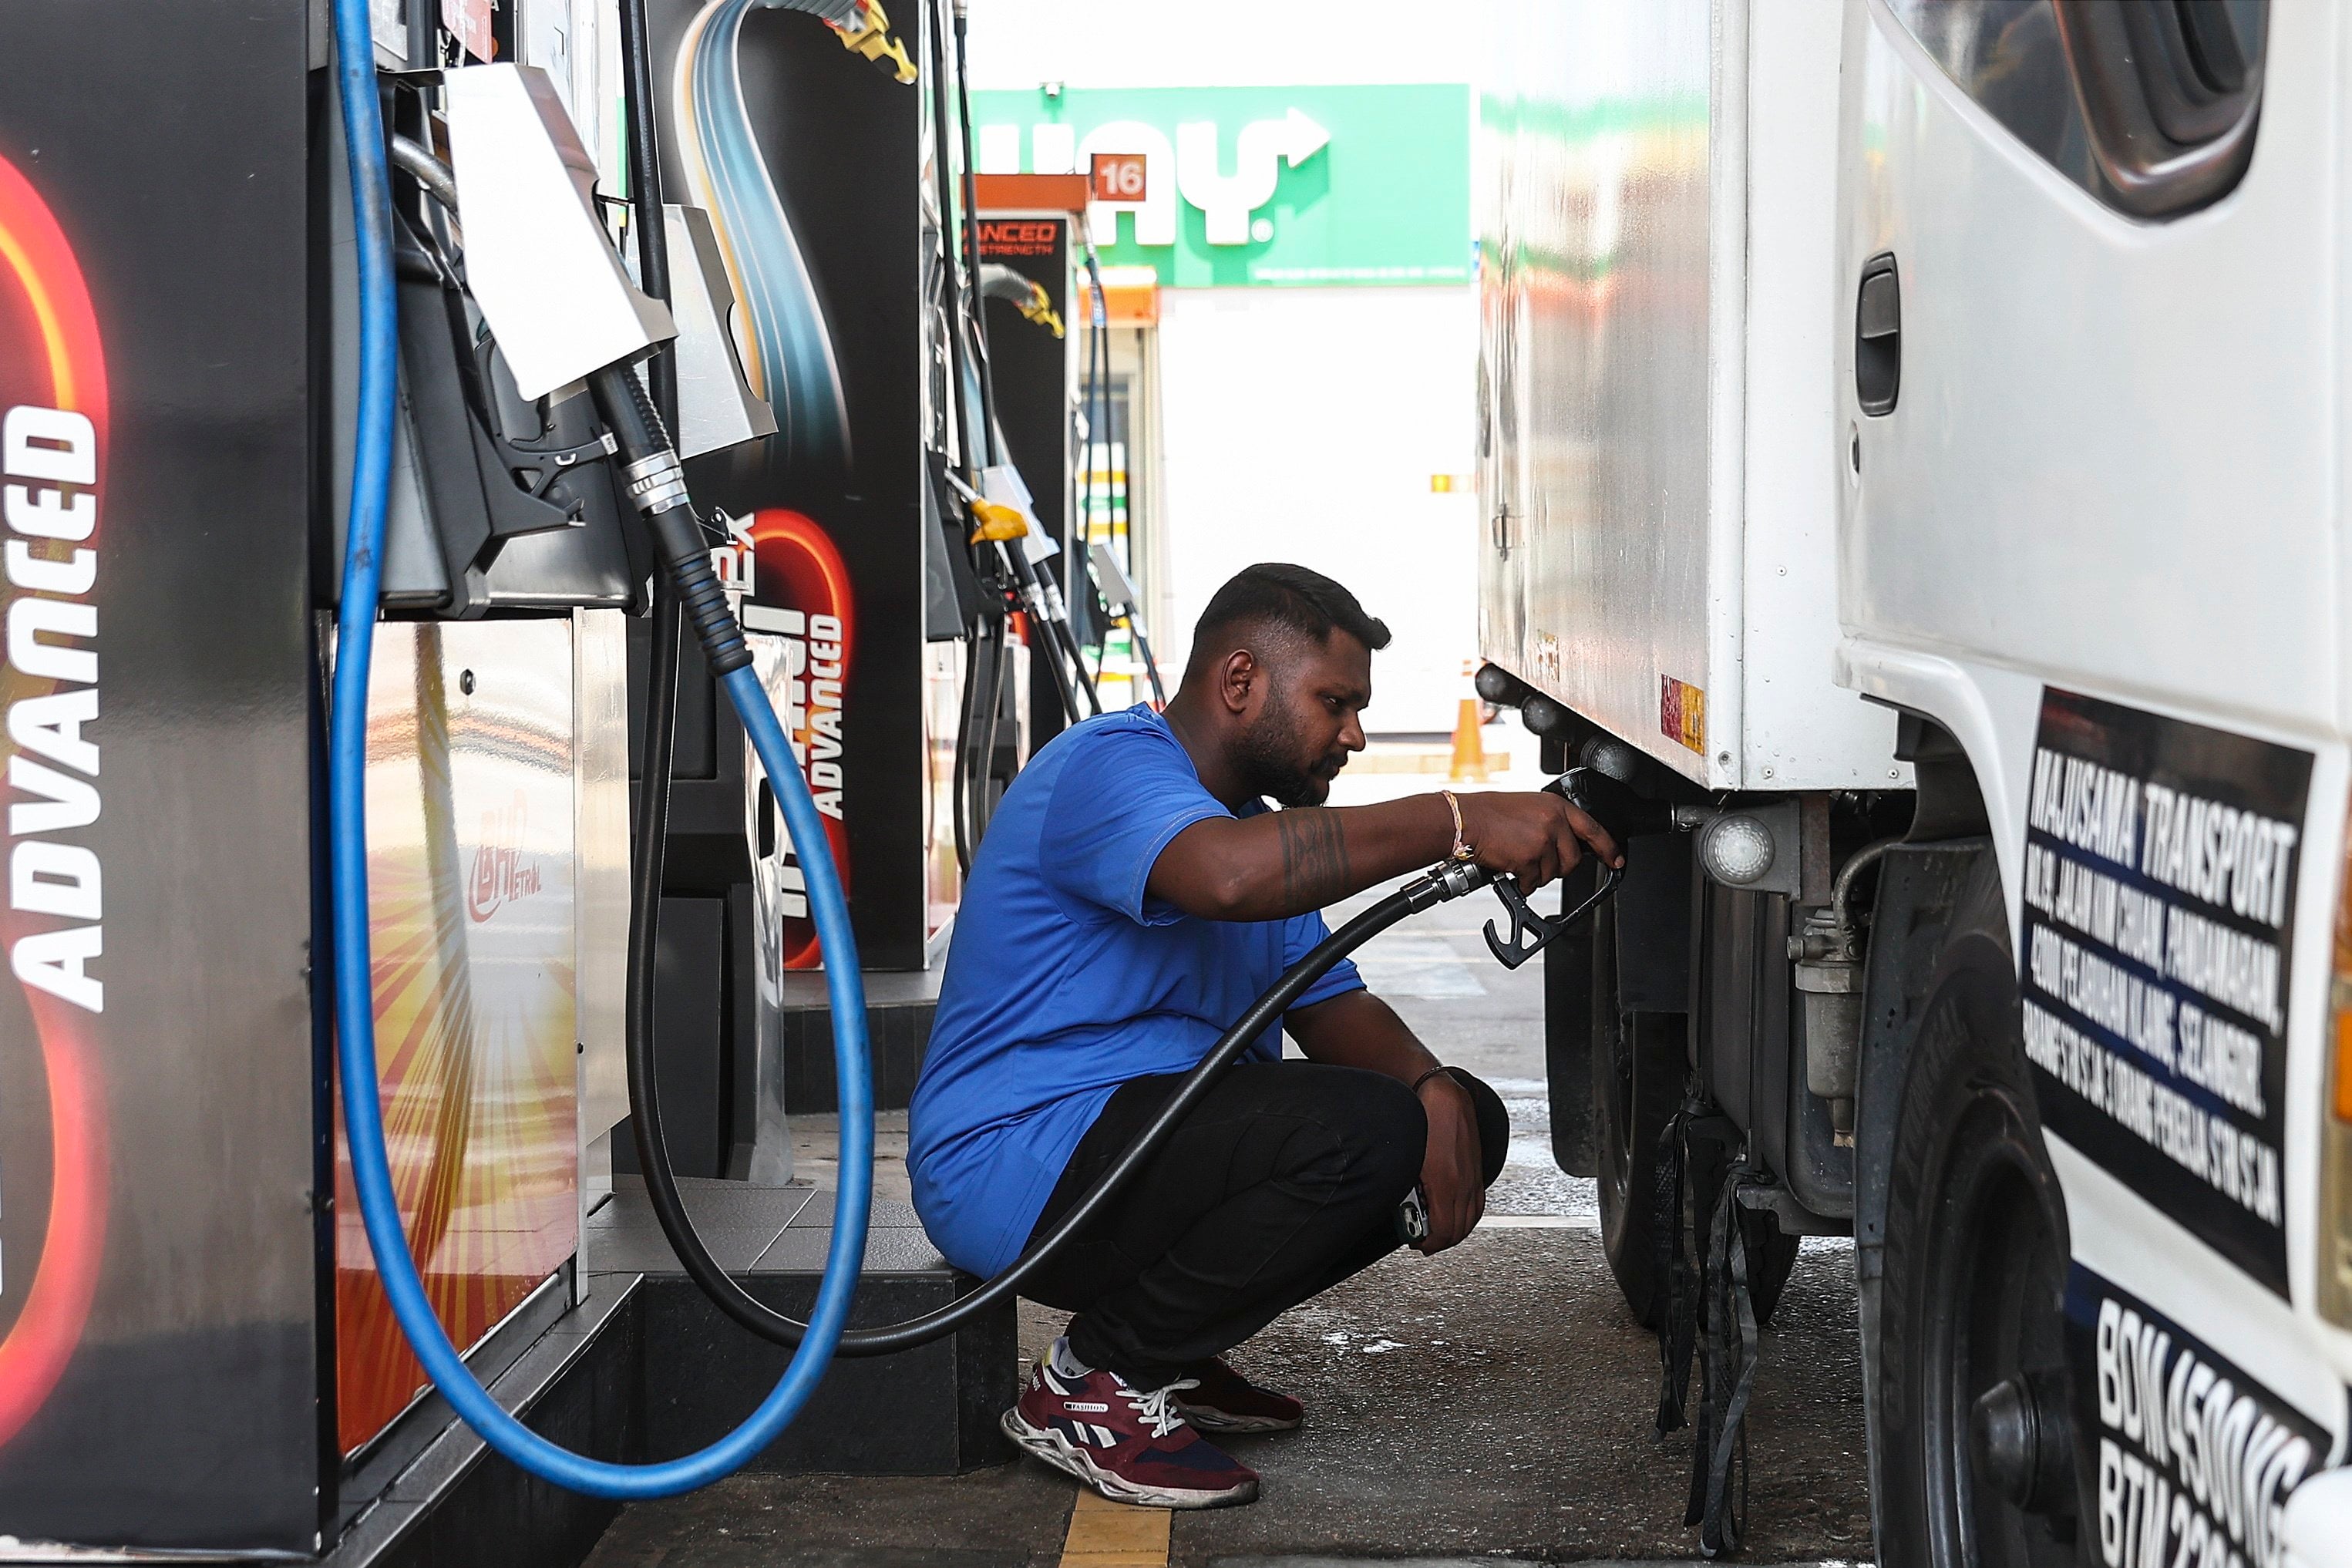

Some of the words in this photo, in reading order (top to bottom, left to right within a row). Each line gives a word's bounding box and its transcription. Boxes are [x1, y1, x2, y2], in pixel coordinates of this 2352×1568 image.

[1100, 162, 1145, 195] 16
[2, 405, 104, 1014] ADVANCED
[809, 613, 843, 821] ADVANCED
[2031, 746, 2139, 870] MAJUSAMA
[2142, 782, 2297, 930] TRANSPORT
[2055, 856, 2093, 936] JALAN
[2105, 1049, 2115, 1118] 3
[1072, 1403, 1105, 1412] FASHION
[2166, 1348, 2312, 1568] 4500KG
[2099, 1435, 2171, 1568] BTM
